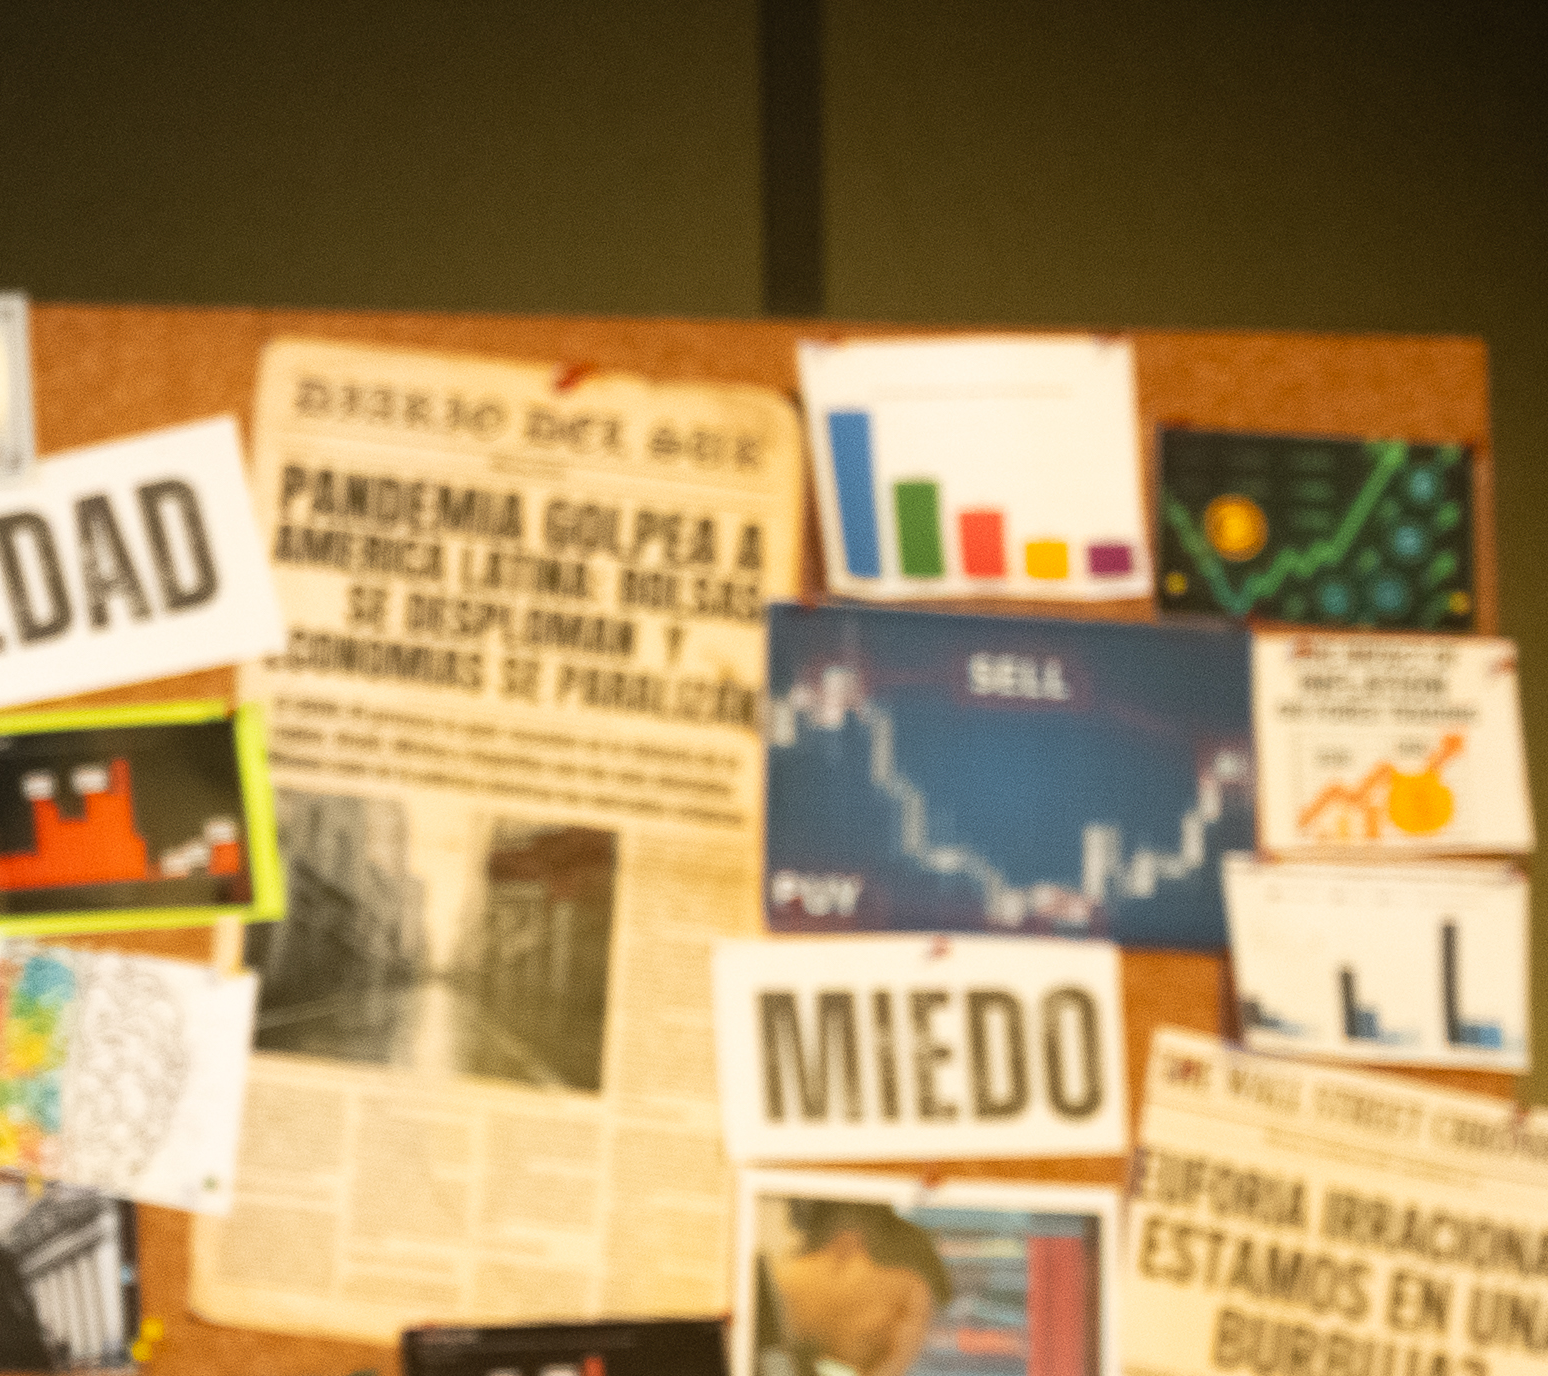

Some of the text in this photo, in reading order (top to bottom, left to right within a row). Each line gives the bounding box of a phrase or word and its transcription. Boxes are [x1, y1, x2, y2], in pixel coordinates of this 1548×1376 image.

[279, 462, 764, 571] PANDEMIA GOLPEA A
[967, 649, 1072, 702] SELL
[758, 985, 1105, 1124] MIEDO
[1136, 1145, 1309, 1230] EUFORIA
[1139, 1216, 1452, 1336] ESTAMOS EN
